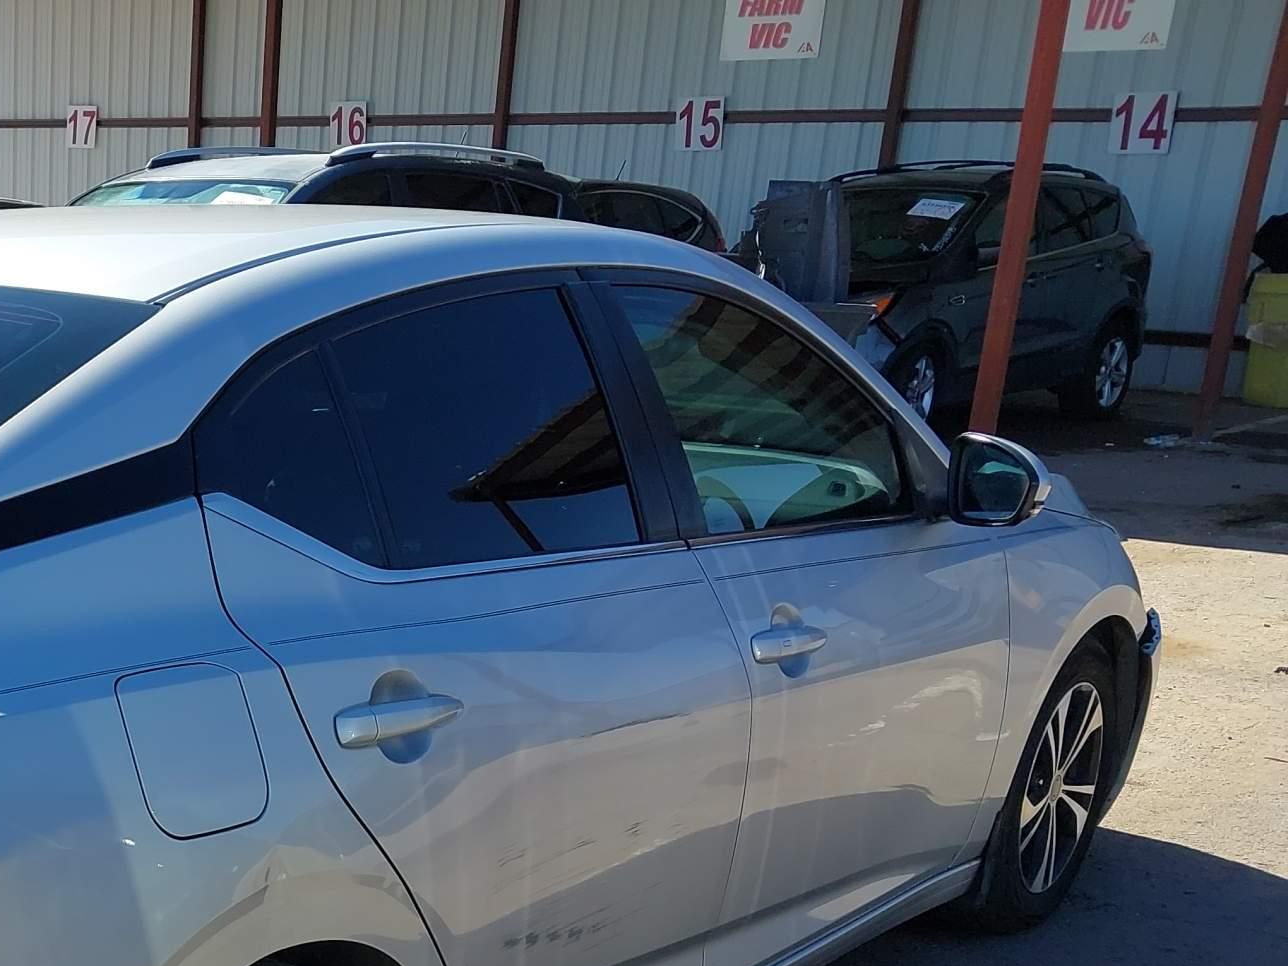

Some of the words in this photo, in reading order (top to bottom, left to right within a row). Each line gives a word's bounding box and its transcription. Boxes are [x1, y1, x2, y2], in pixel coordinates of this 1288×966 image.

[748, 21, 793, 49] VIC
[68, 109, 96, 145] 17
[331, 105, 365, 146] 16
[679, 100, 721, 148] 15
[1115, 94, 1169, 150] 14
